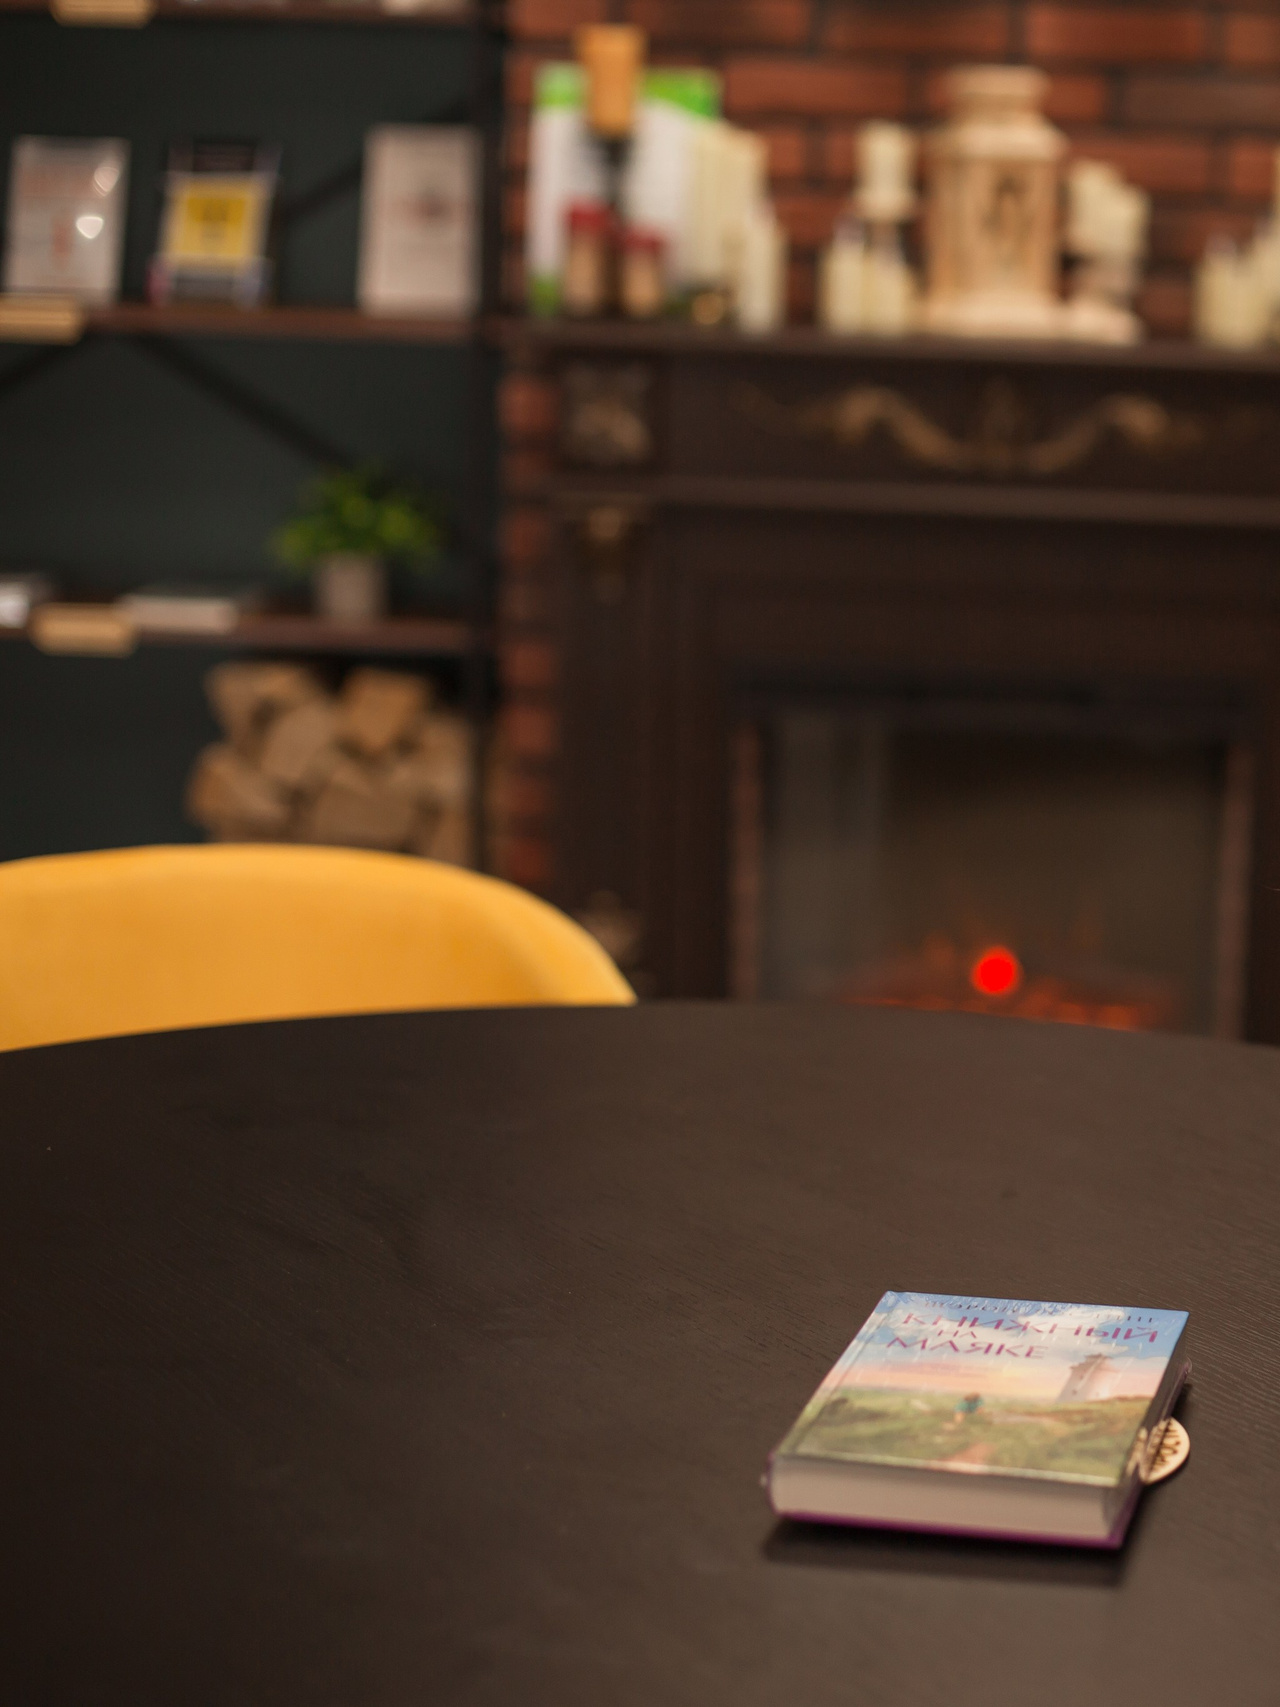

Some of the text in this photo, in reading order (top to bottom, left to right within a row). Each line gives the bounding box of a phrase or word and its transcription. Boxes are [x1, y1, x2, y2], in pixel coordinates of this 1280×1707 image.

[903, 1312, 1158, 1343] КНИЖНЫЙ
[937, 1330, 977, 1339] НА
[887, 1336, 1049, 1359] МАЯКЕ
